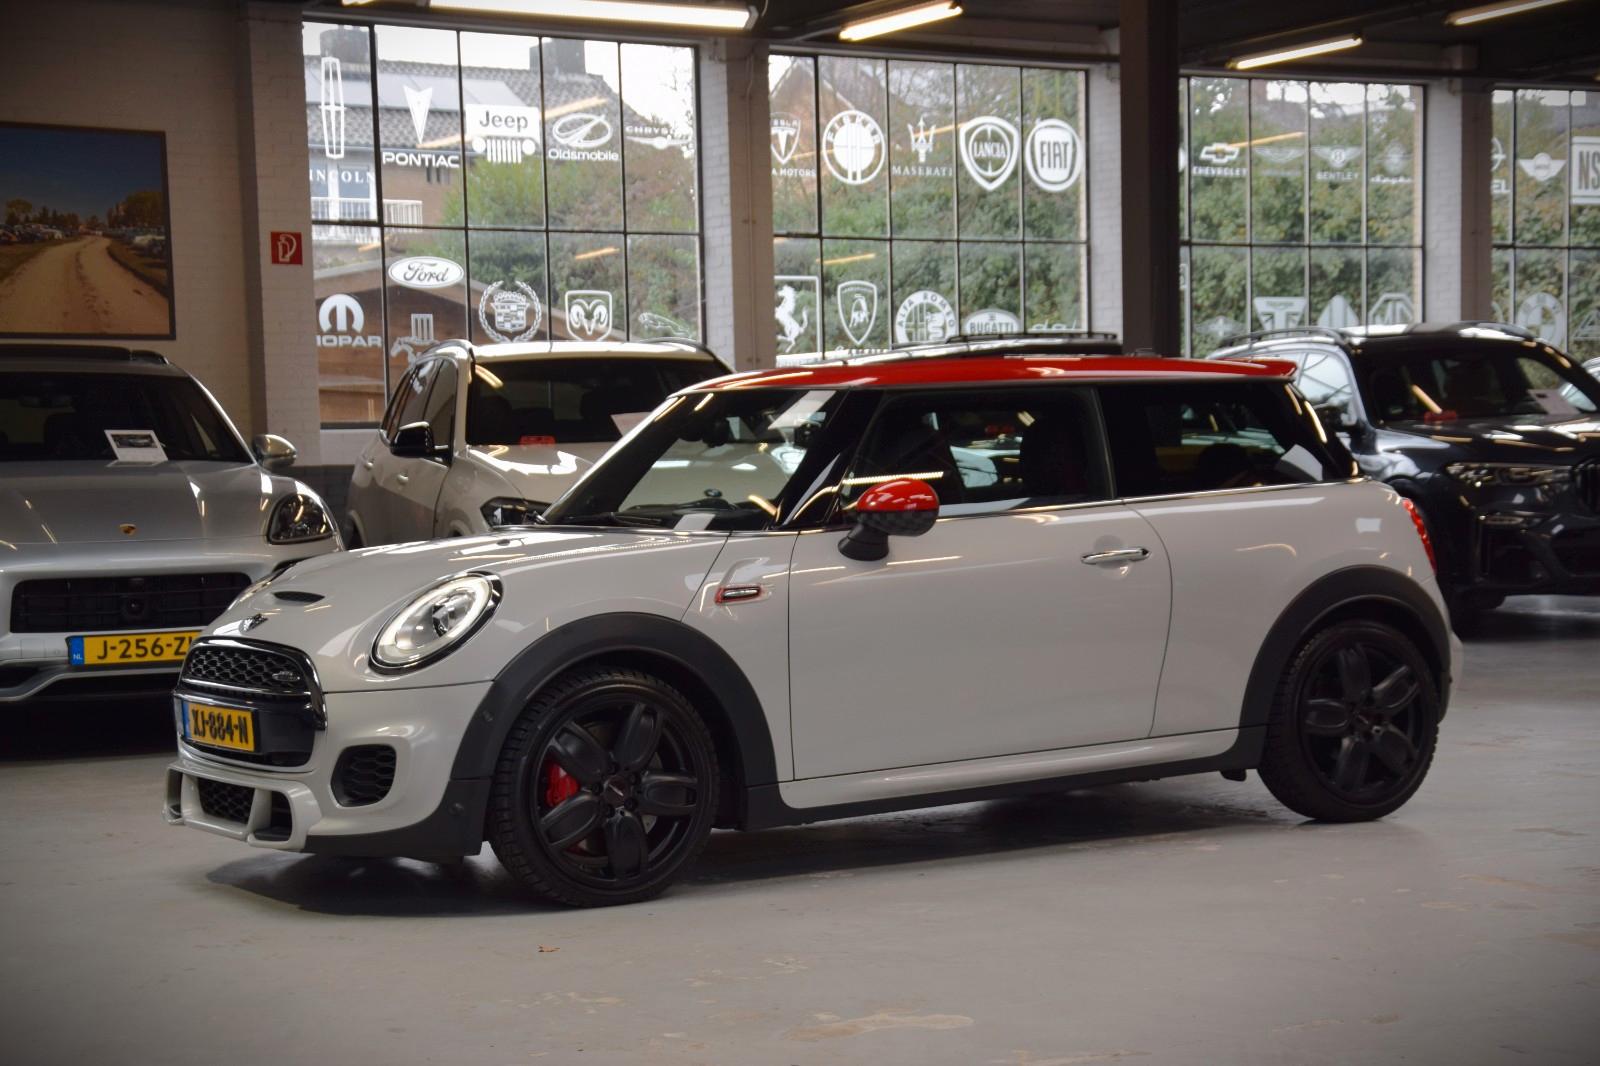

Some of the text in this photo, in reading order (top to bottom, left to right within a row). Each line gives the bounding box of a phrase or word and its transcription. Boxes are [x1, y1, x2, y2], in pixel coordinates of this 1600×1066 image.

[479, 110, 529, 133] Jeep
[548, 147, 619, 162] Oldsmobile
[973, 141, 1007, 159] LANCIA
[1039, 140, 1070, 169] FIAT
[382, 151, 460, 169] PONTIAC
[892, 165, 953, 177] MASERATI
[403, 260, 449, 283] Ford
[969, 321, 1014, 334] BUGATTI
[315, 334, 382, 348] OPAR
[97, 636, 193, 660] J-256-Z
[191, 708, 250, 745] XJ-884-N
